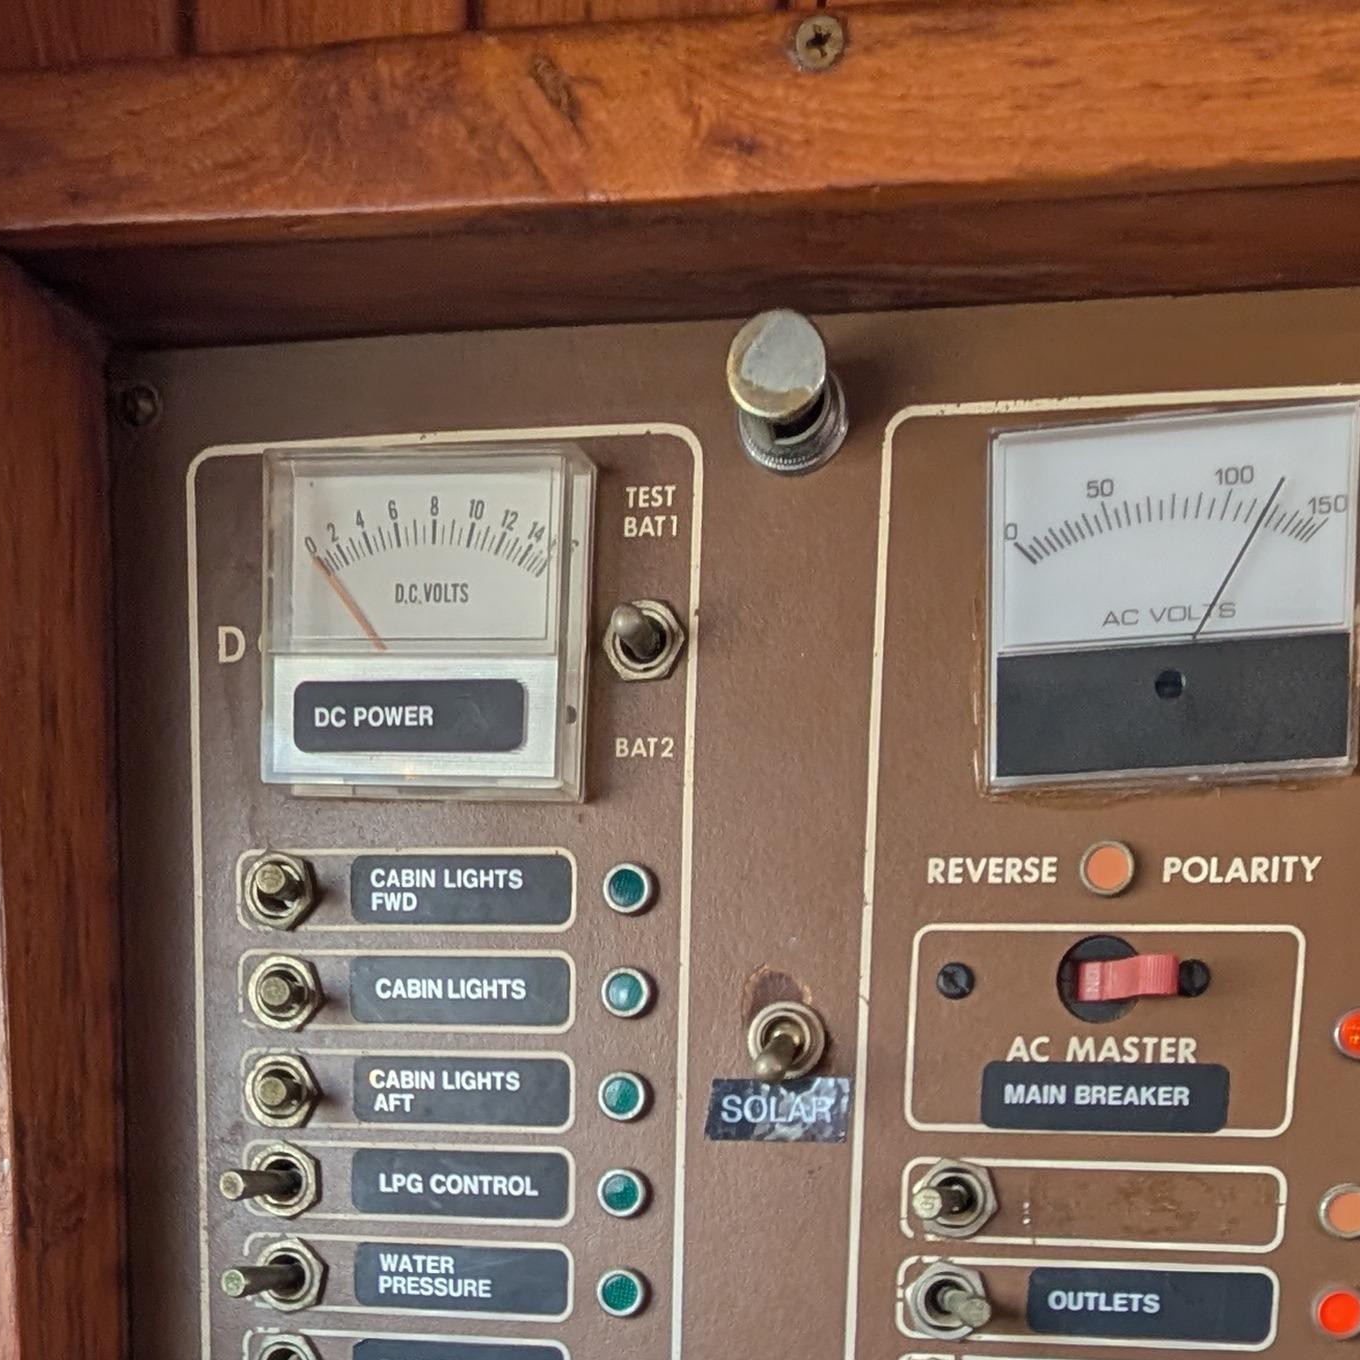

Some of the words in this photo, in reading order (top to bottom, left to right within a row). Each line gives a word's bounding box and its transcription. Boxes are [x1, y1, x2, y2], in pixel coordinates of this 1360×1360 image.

[625, 486, 676, 508] TEST
[1003, 523, 1018, 542] 0
[1086, 479, 1114, 497] 50
[1214, 466, 1255, 485] 100
[1307, 495, 1348, 515] 150
[327, 523, 338, 543] 2
[355, 509, 364, 528] 4
[388, 501, 398, 520] 6
[430, 496, 439, 517] 8
[469, 500, 485, 520] 10
[501, 509, 519, 532] 12
[527, 521, 545, 544] 14
[1102, 608, 1139, 628] AC
[1148, 602, 1237, 623] VOLTS
[314, 707, 346, 728] DC
[353, 706, 434, 727] POWER
[615, 738, 674, 758] BAT2
[370, 869, 436, 889] CABIN
[443, 868, 523, 889] LIGHTS
[927, 856, 1058, 885] REVERSE
[1162, 855, 1323, 883] POLARITY
[371, 893, 417, 912] FWD
[375, 979, 442, 999] CABIN
[447, 978, 526, 1000] LIGHTS
[1006, 1037, 1050, 1061] AC
[1066, 1037, 1197, 1064] MASTER
[369, 1069, 435, 1090] CABIN
[442, 1070, 520, 1091] LIGHTS
[374, 1094, 414, 1112] AFT
[1003, 1084, 1065, 1105] MAIN
[1074, 1084, 1190, 1107] BREAKER
[720, 1093, 834, 1124] SOLAR
[379, 1173, 423, 1194] LPG
[429, 1174, 538, 1197] CONTROL
[380, 1253, 455, 1274] WATER
[378, 1277, 492, 1298] PRESSURE
[1047, 1291, 1161, 1313] OUTLETS
